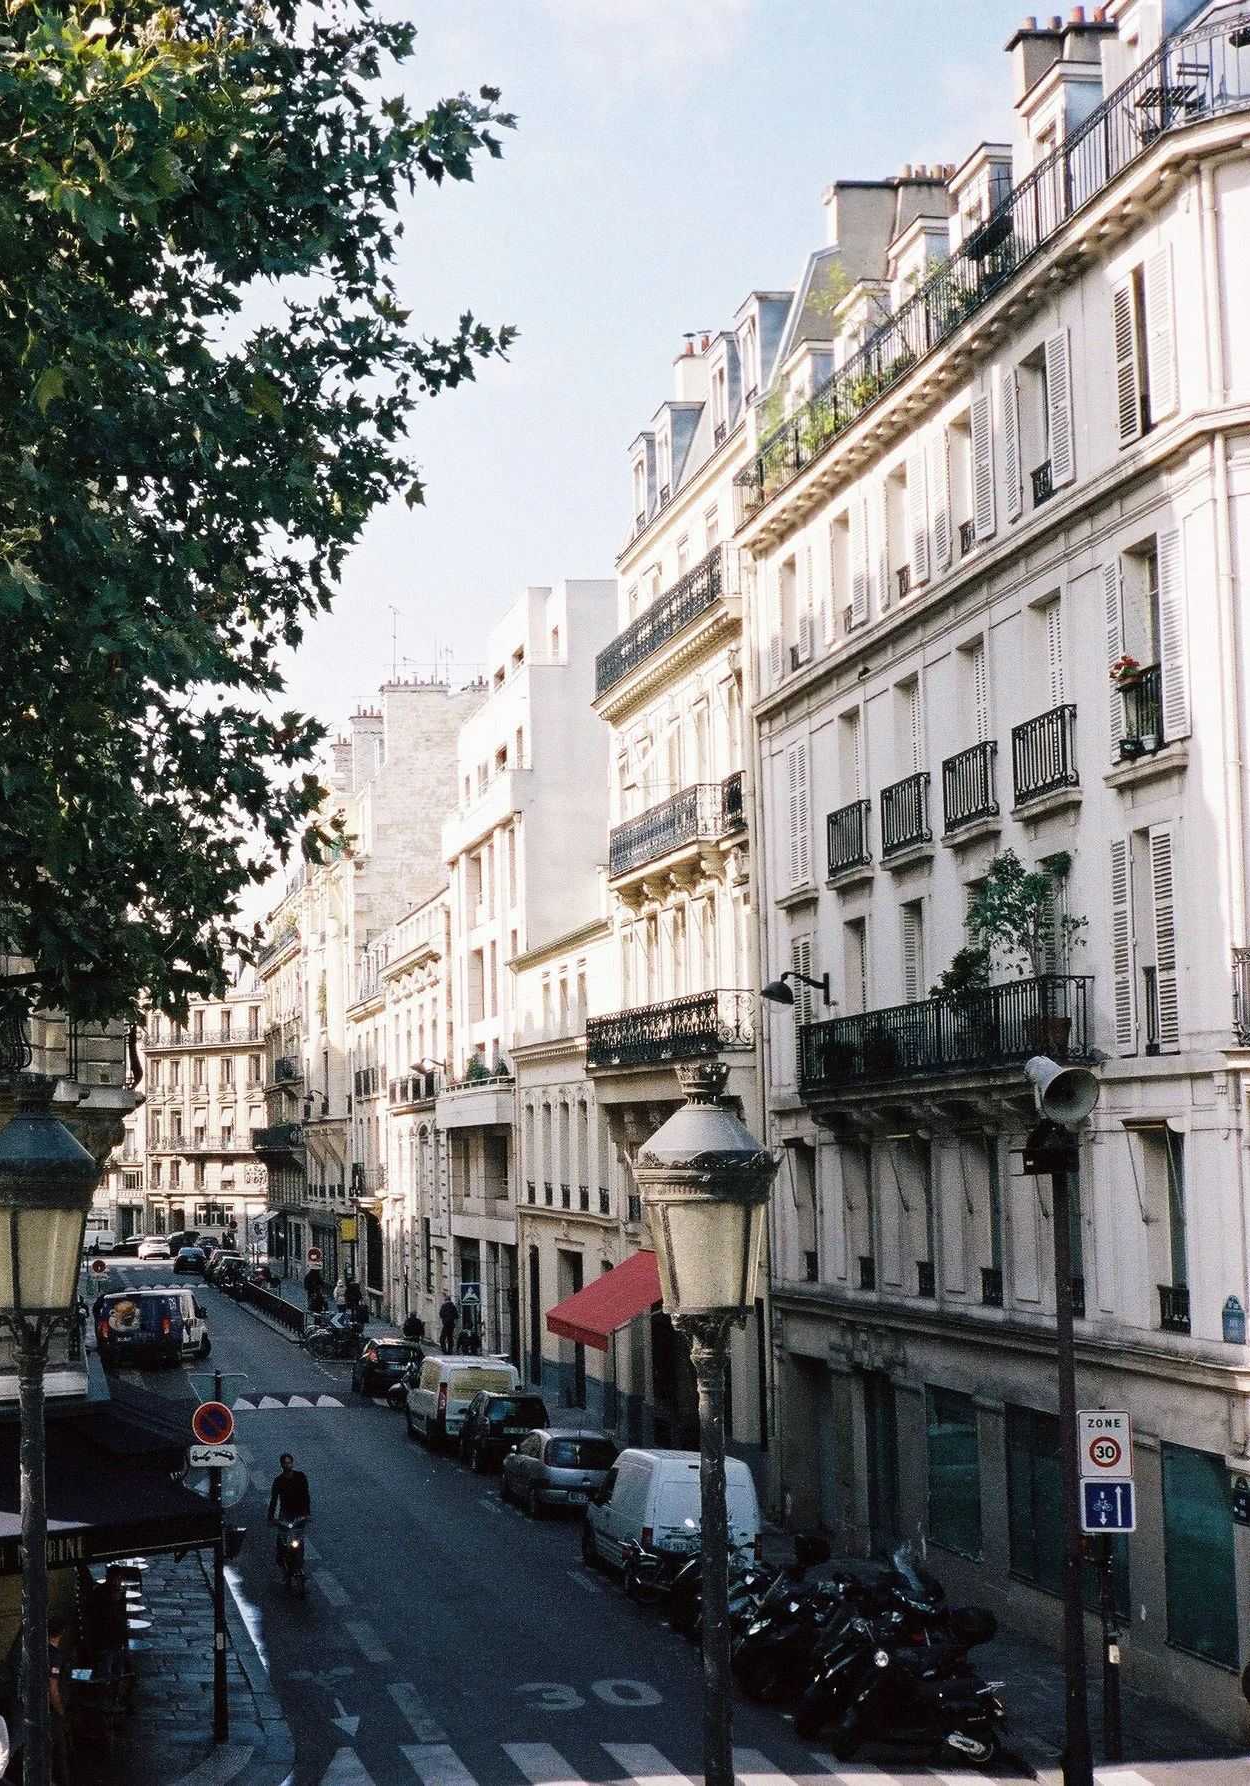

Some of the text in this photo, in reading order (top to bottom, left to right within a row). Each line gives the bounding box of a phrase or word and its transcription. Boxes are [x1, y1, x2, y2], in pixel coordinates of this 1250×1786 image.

[1087, 1419, 1122, 1428] ZONE
[1095, 1446, 1115, 1459] 30
[514, 1678, 664, 1711] 30
